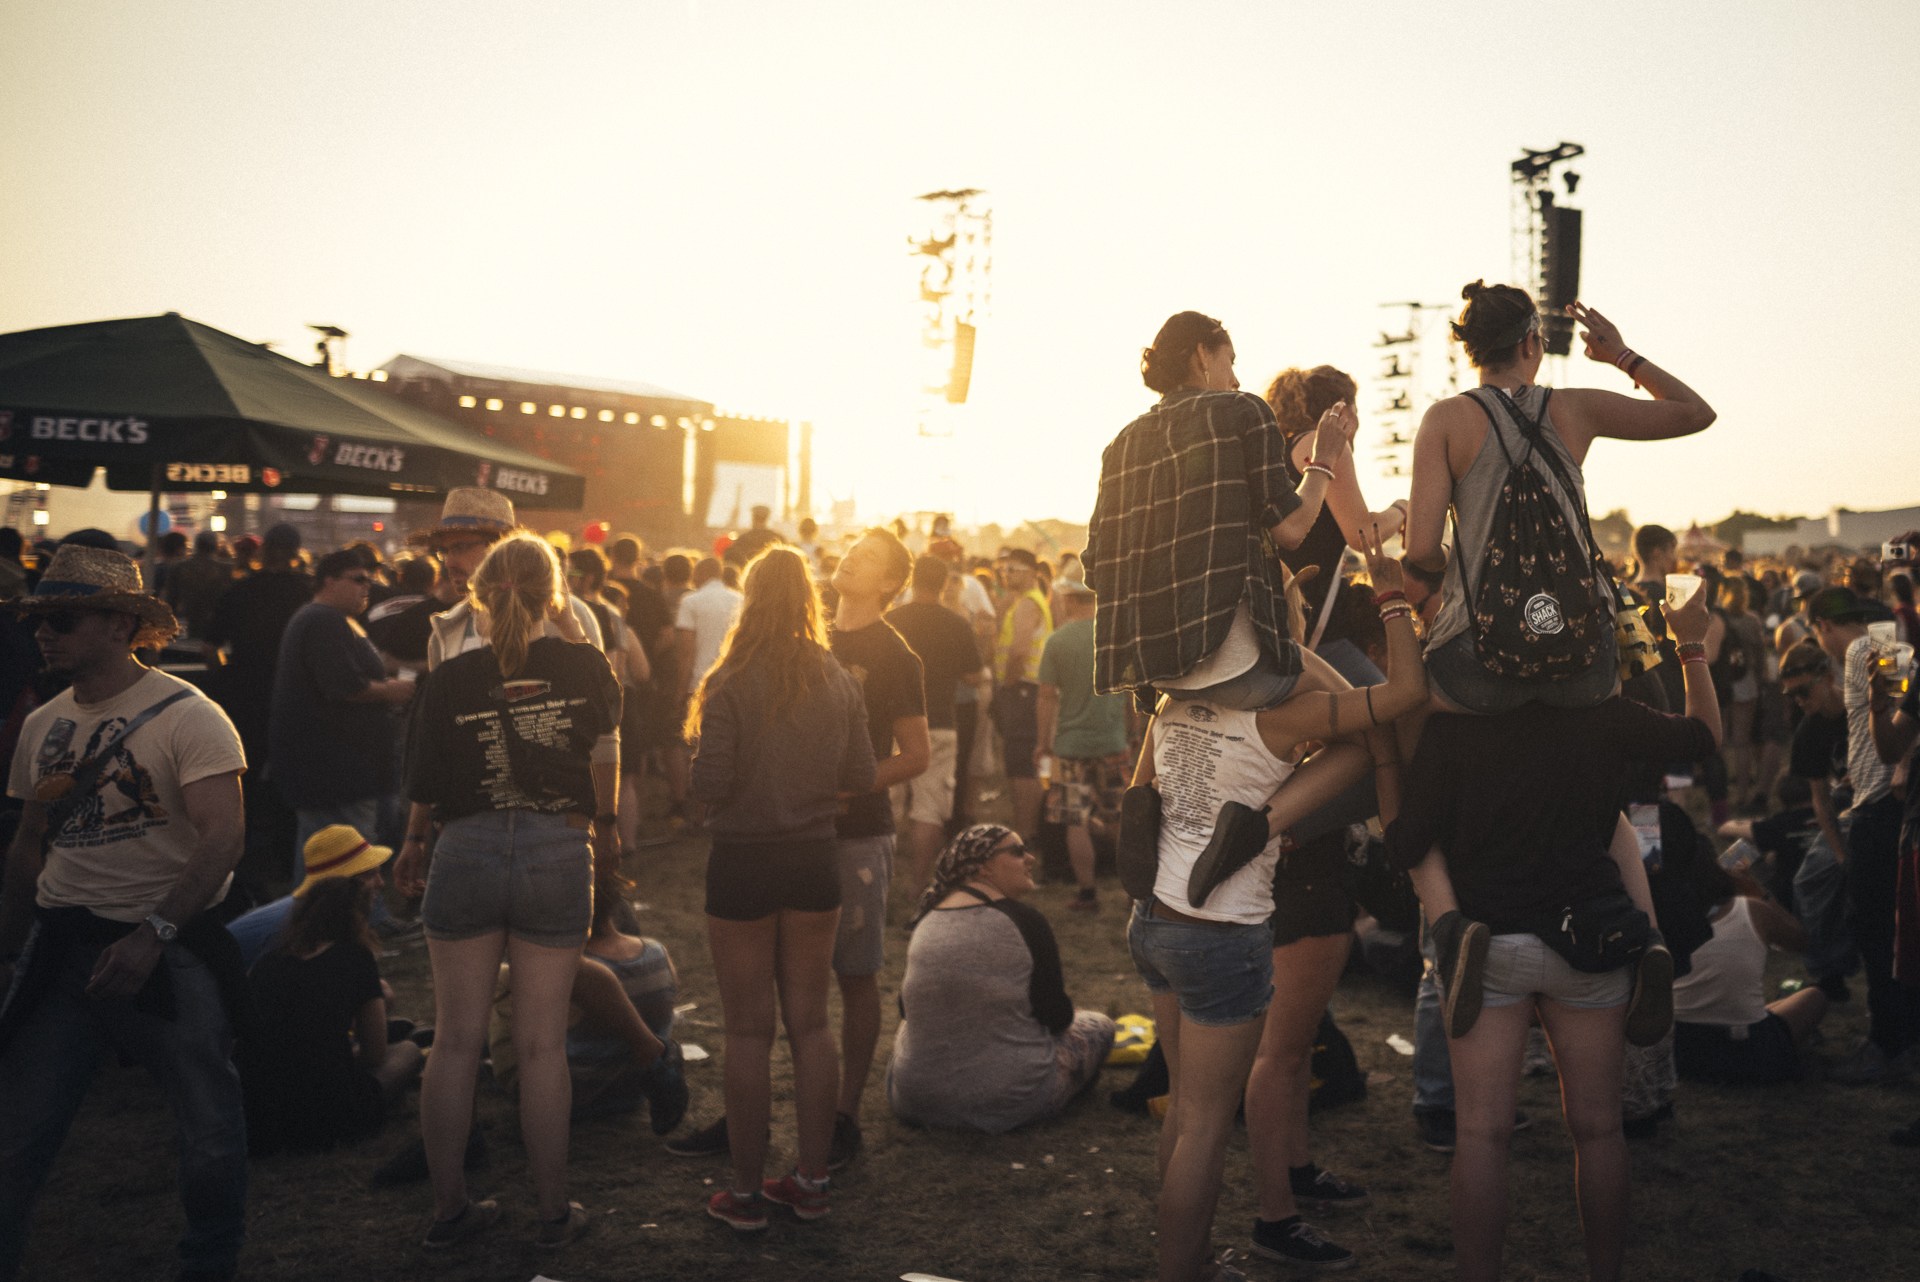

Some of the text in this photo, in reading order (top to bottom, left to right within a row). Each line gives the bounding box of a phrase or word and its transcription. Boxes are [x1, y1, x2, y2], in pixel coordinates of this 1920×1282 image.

[31, 416, 148, 444] BECK'S
[333, 443, 404, 472] BECK'S
[496, 468, 548, 495] BECK'S
[1531, 604, 1558, 625] SHACK
